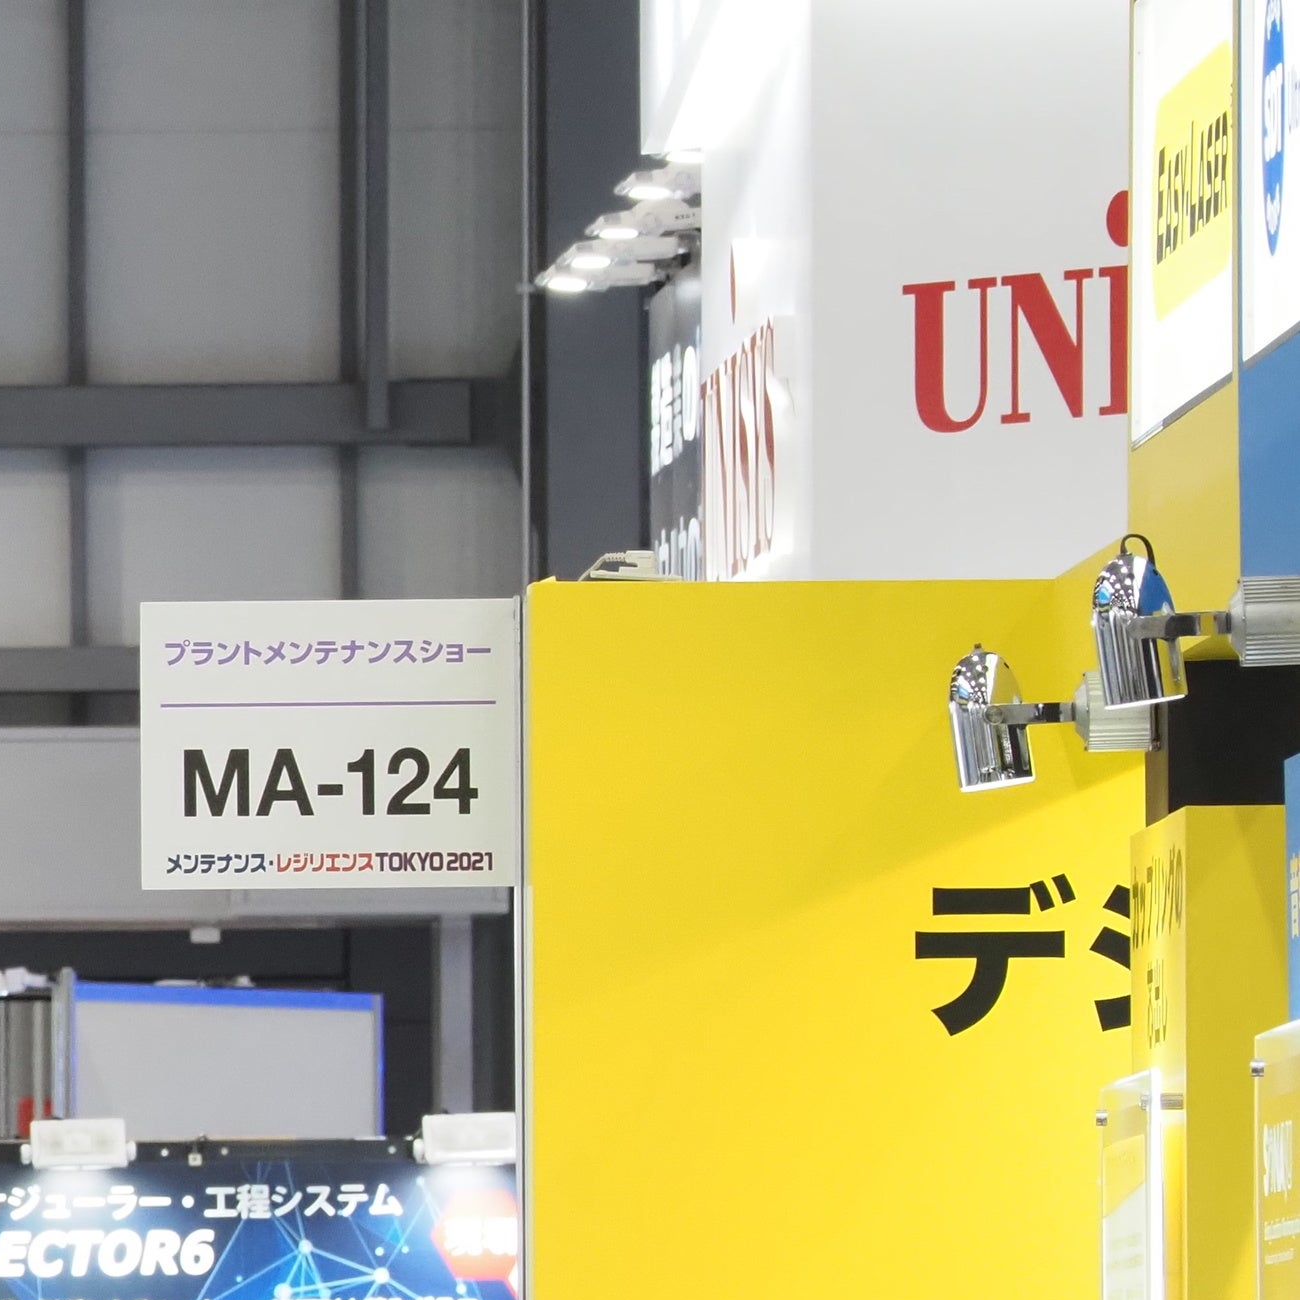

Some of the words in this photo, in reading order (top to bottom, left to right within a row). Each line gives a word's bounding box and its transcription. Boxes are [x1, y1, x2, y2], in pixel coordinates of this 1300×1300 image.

[165, 640, 492, 666] プラントメンテナンスショー
[183, 747, 479, 817] MA-124
